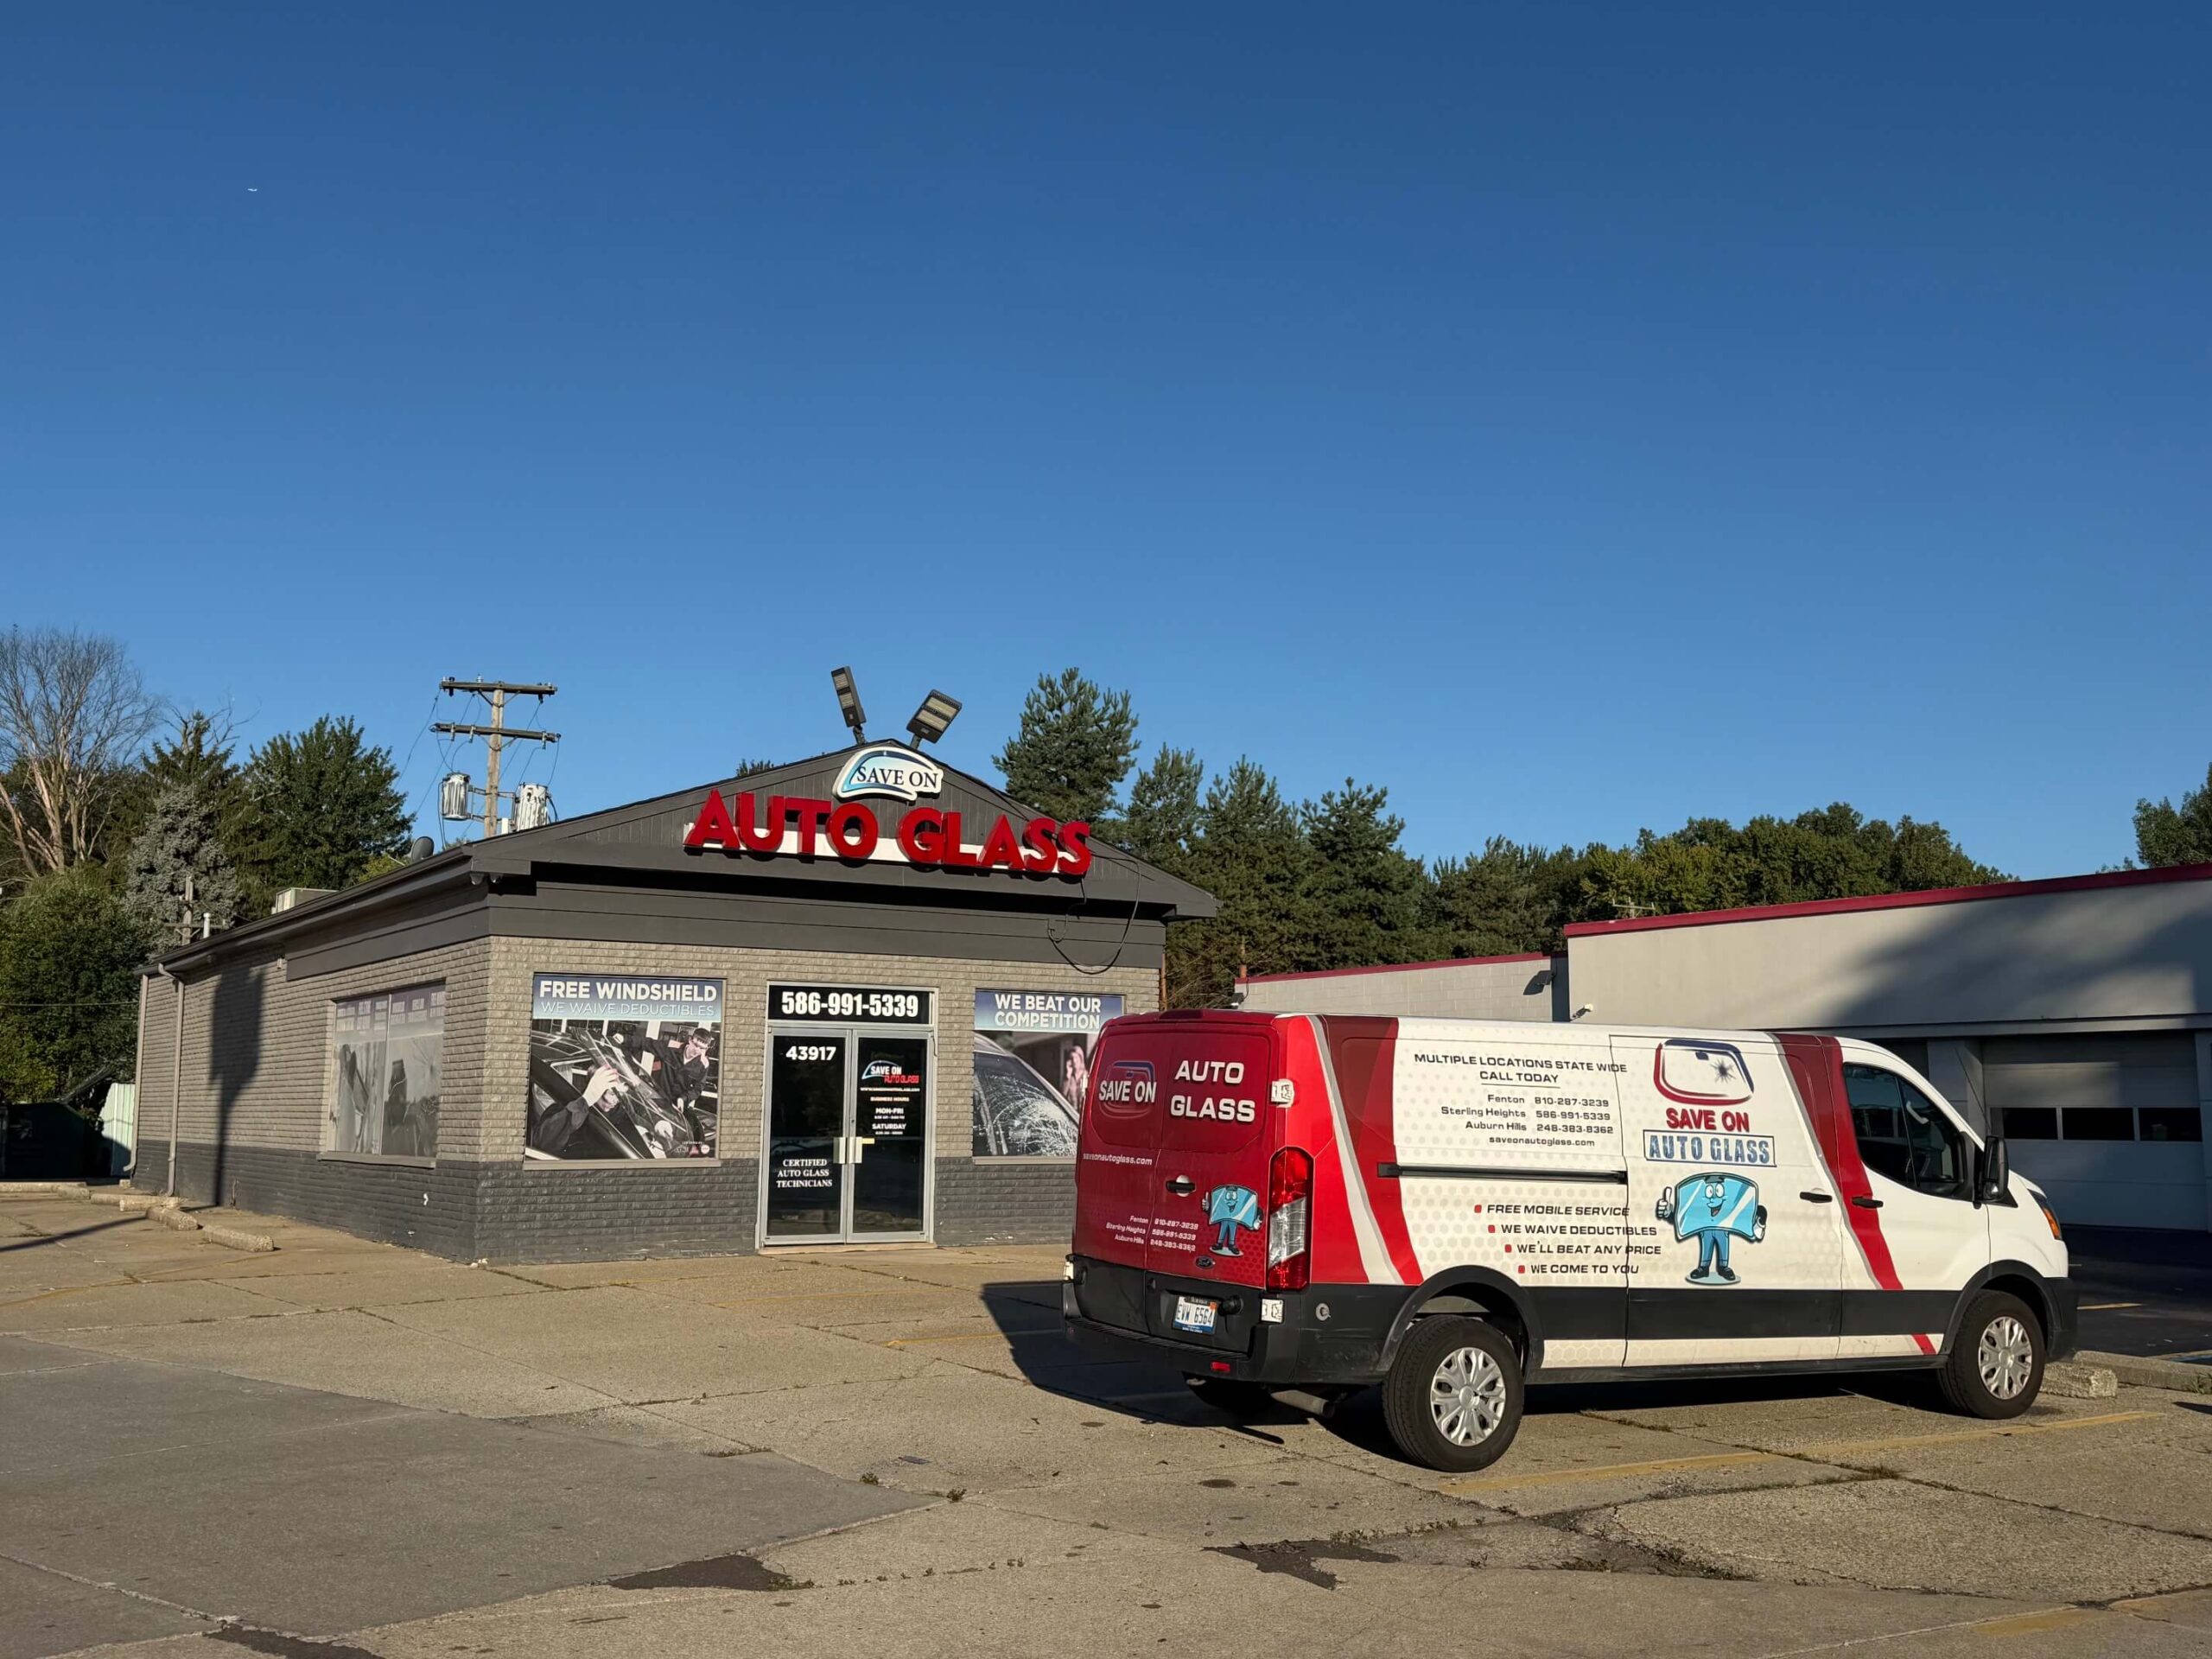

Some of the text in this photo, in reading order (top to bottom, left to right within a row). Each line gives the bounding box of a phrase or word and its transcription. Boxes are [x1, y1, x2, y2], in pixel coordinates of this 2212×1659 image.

[857, 766, 939, 789] SAVE ON
[683, 789, 1092, 875] AUTO GLASS
[540, 980, 717, 1002] FREE WINDSHIELD
[541, 1001, 715, 1016] WE WAIVE DEDUCTIBLES
[781, 991, 918, 1017] 586-991-5339
[995, 994, 1102, 1013] WE BEAT OUR
[995, 1011, 1100, 1029] COMPETITION
[785, 1046, 836, 1061] 43917
[870, 1065, 902, 1076] SAVE ON
[1414, 1053, 1628, 1073] MULTIPLE LOCATIONS STATE WIDE
[1174, 1059, 1245, 1084] AUTO
[1479, 1071, 1559, 1084] CALL TODAY
[884, 1075, 919, 1084] AUTO GLASS
[1098, 1080, 1157, 1103] SAVE ON
[1170, 1095, 1255, 1122] GLASS
[1487, 1094, 1610, 1108] Fenton 810-287-3239
[1440, 1106, 1611, 1121] Sterling Heights 586-991-5339
[1665, 1107, 1750, 1133] SAVE ON
[1465, 1121, 1614, 1135] Auburn Hills 248-383-8362
[1489, 1136, 1595, 1147] saveonautoglass.com
[1649, 1135, 1770, 1164] AUTO GLASS
[1487, 1205, 1630, 1217] FREE MOBILE SERVICE
[1129, 1215, 1149, 1224] Fenton
[1501, 1224, 1657, 1236] WE WAIVE DEDUCTIBLES
[1114, 1234, 1134, 1243] Auburn
[1516, 1241, 1662, 1255] WE'LL BEAT ANY PRICE
[1530, 1264, 1640, 1274] WE COME TO YOU
[1193, 1306, 1214, 1325] 6564
